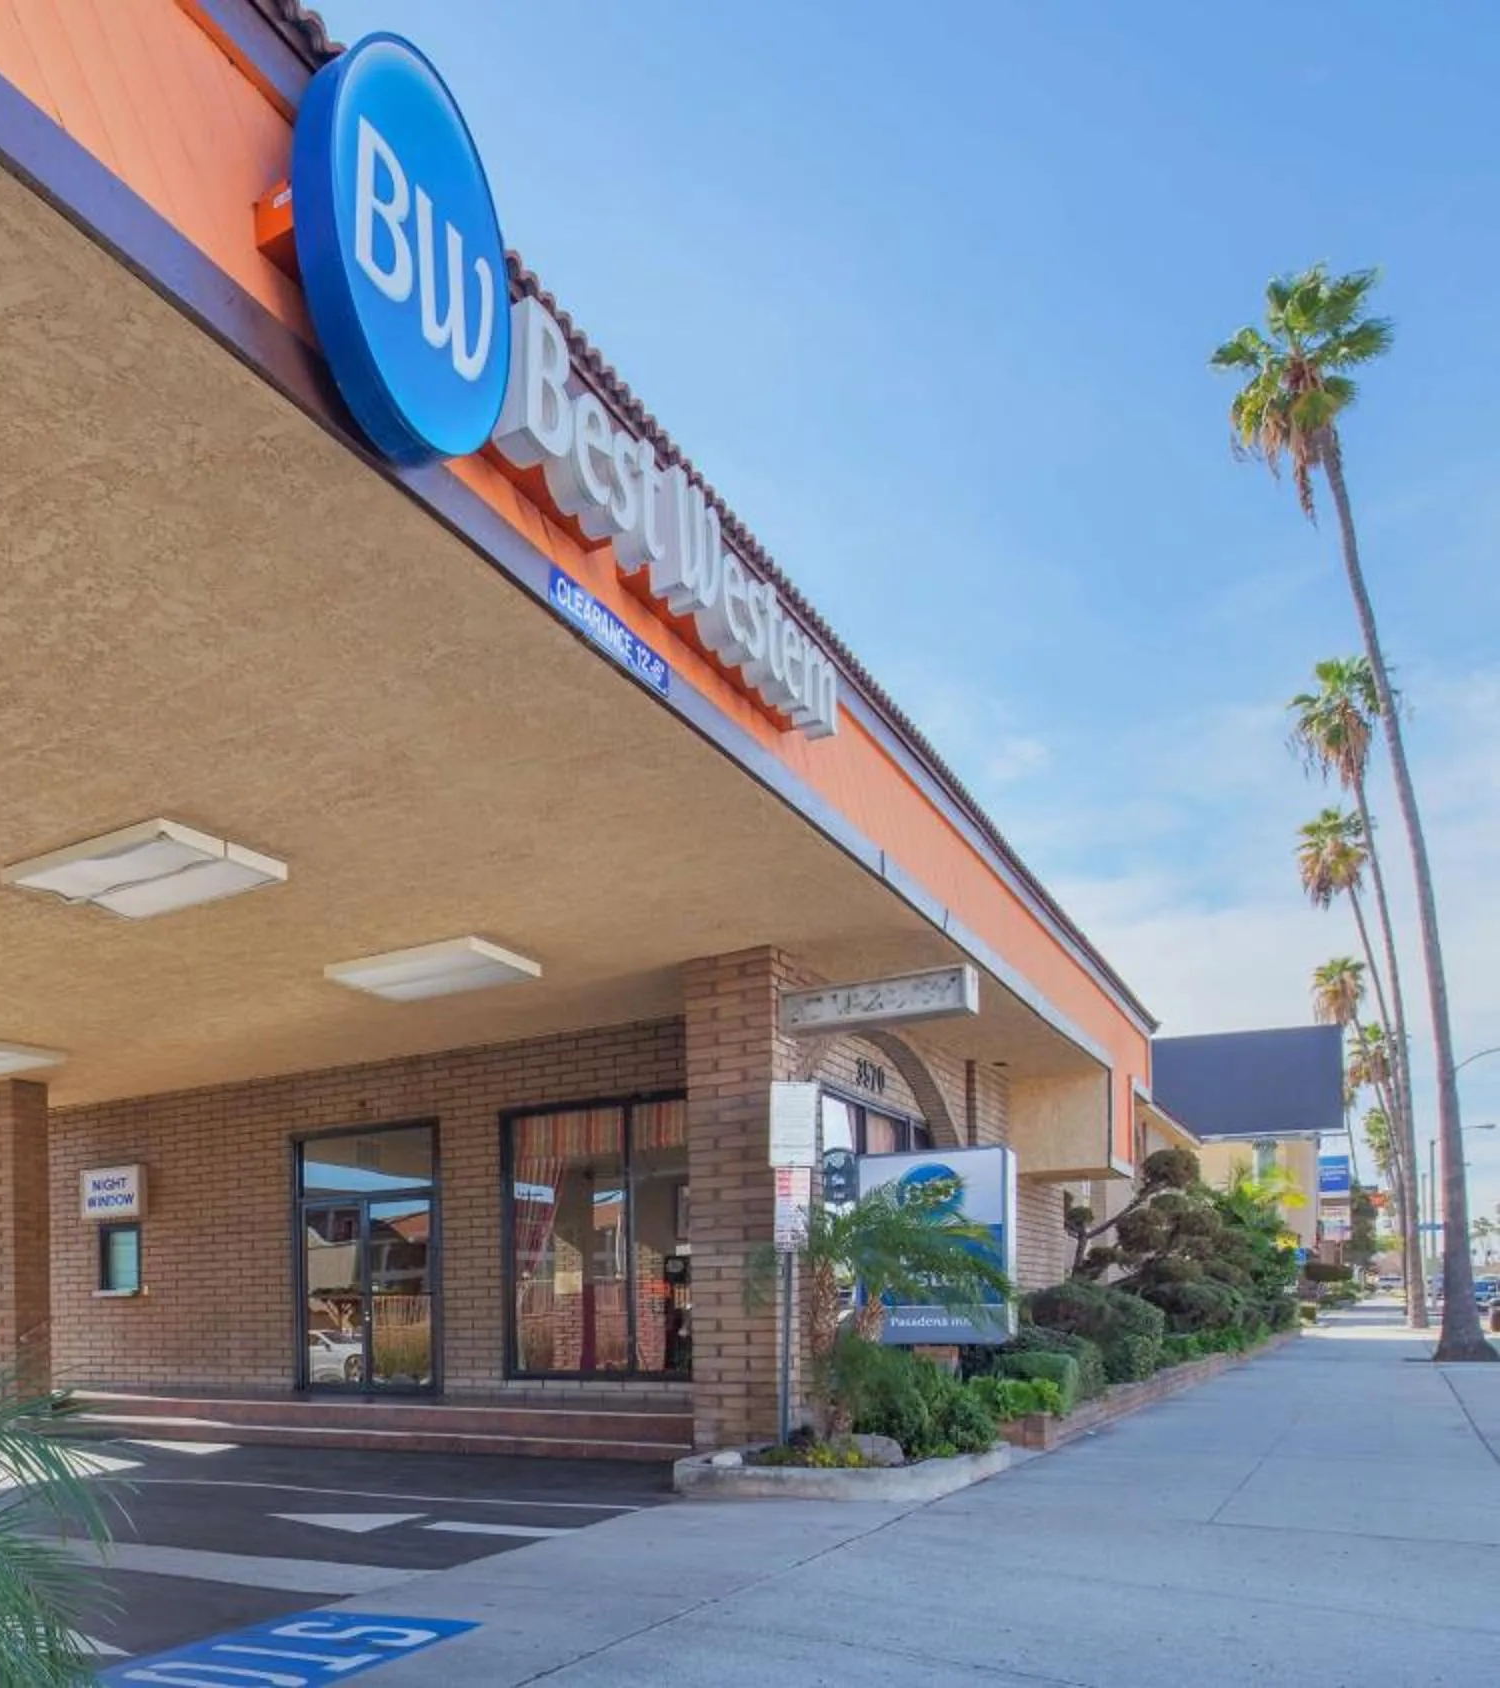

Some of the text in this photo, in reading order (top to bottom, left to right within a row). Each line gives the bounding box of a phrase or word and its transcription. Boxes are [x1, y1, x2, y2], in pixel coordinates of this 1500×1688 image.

[354, 113, 493, 382] BW
[510, 294, 838, 738] Best Western
[556, 577, 634, 660] CLEARANCE
[855, 1057, 885, 1094] 3570
[87, 1192, 135, 1208] WINDOW
[91, 1177, 128, 1192] NIGHT
